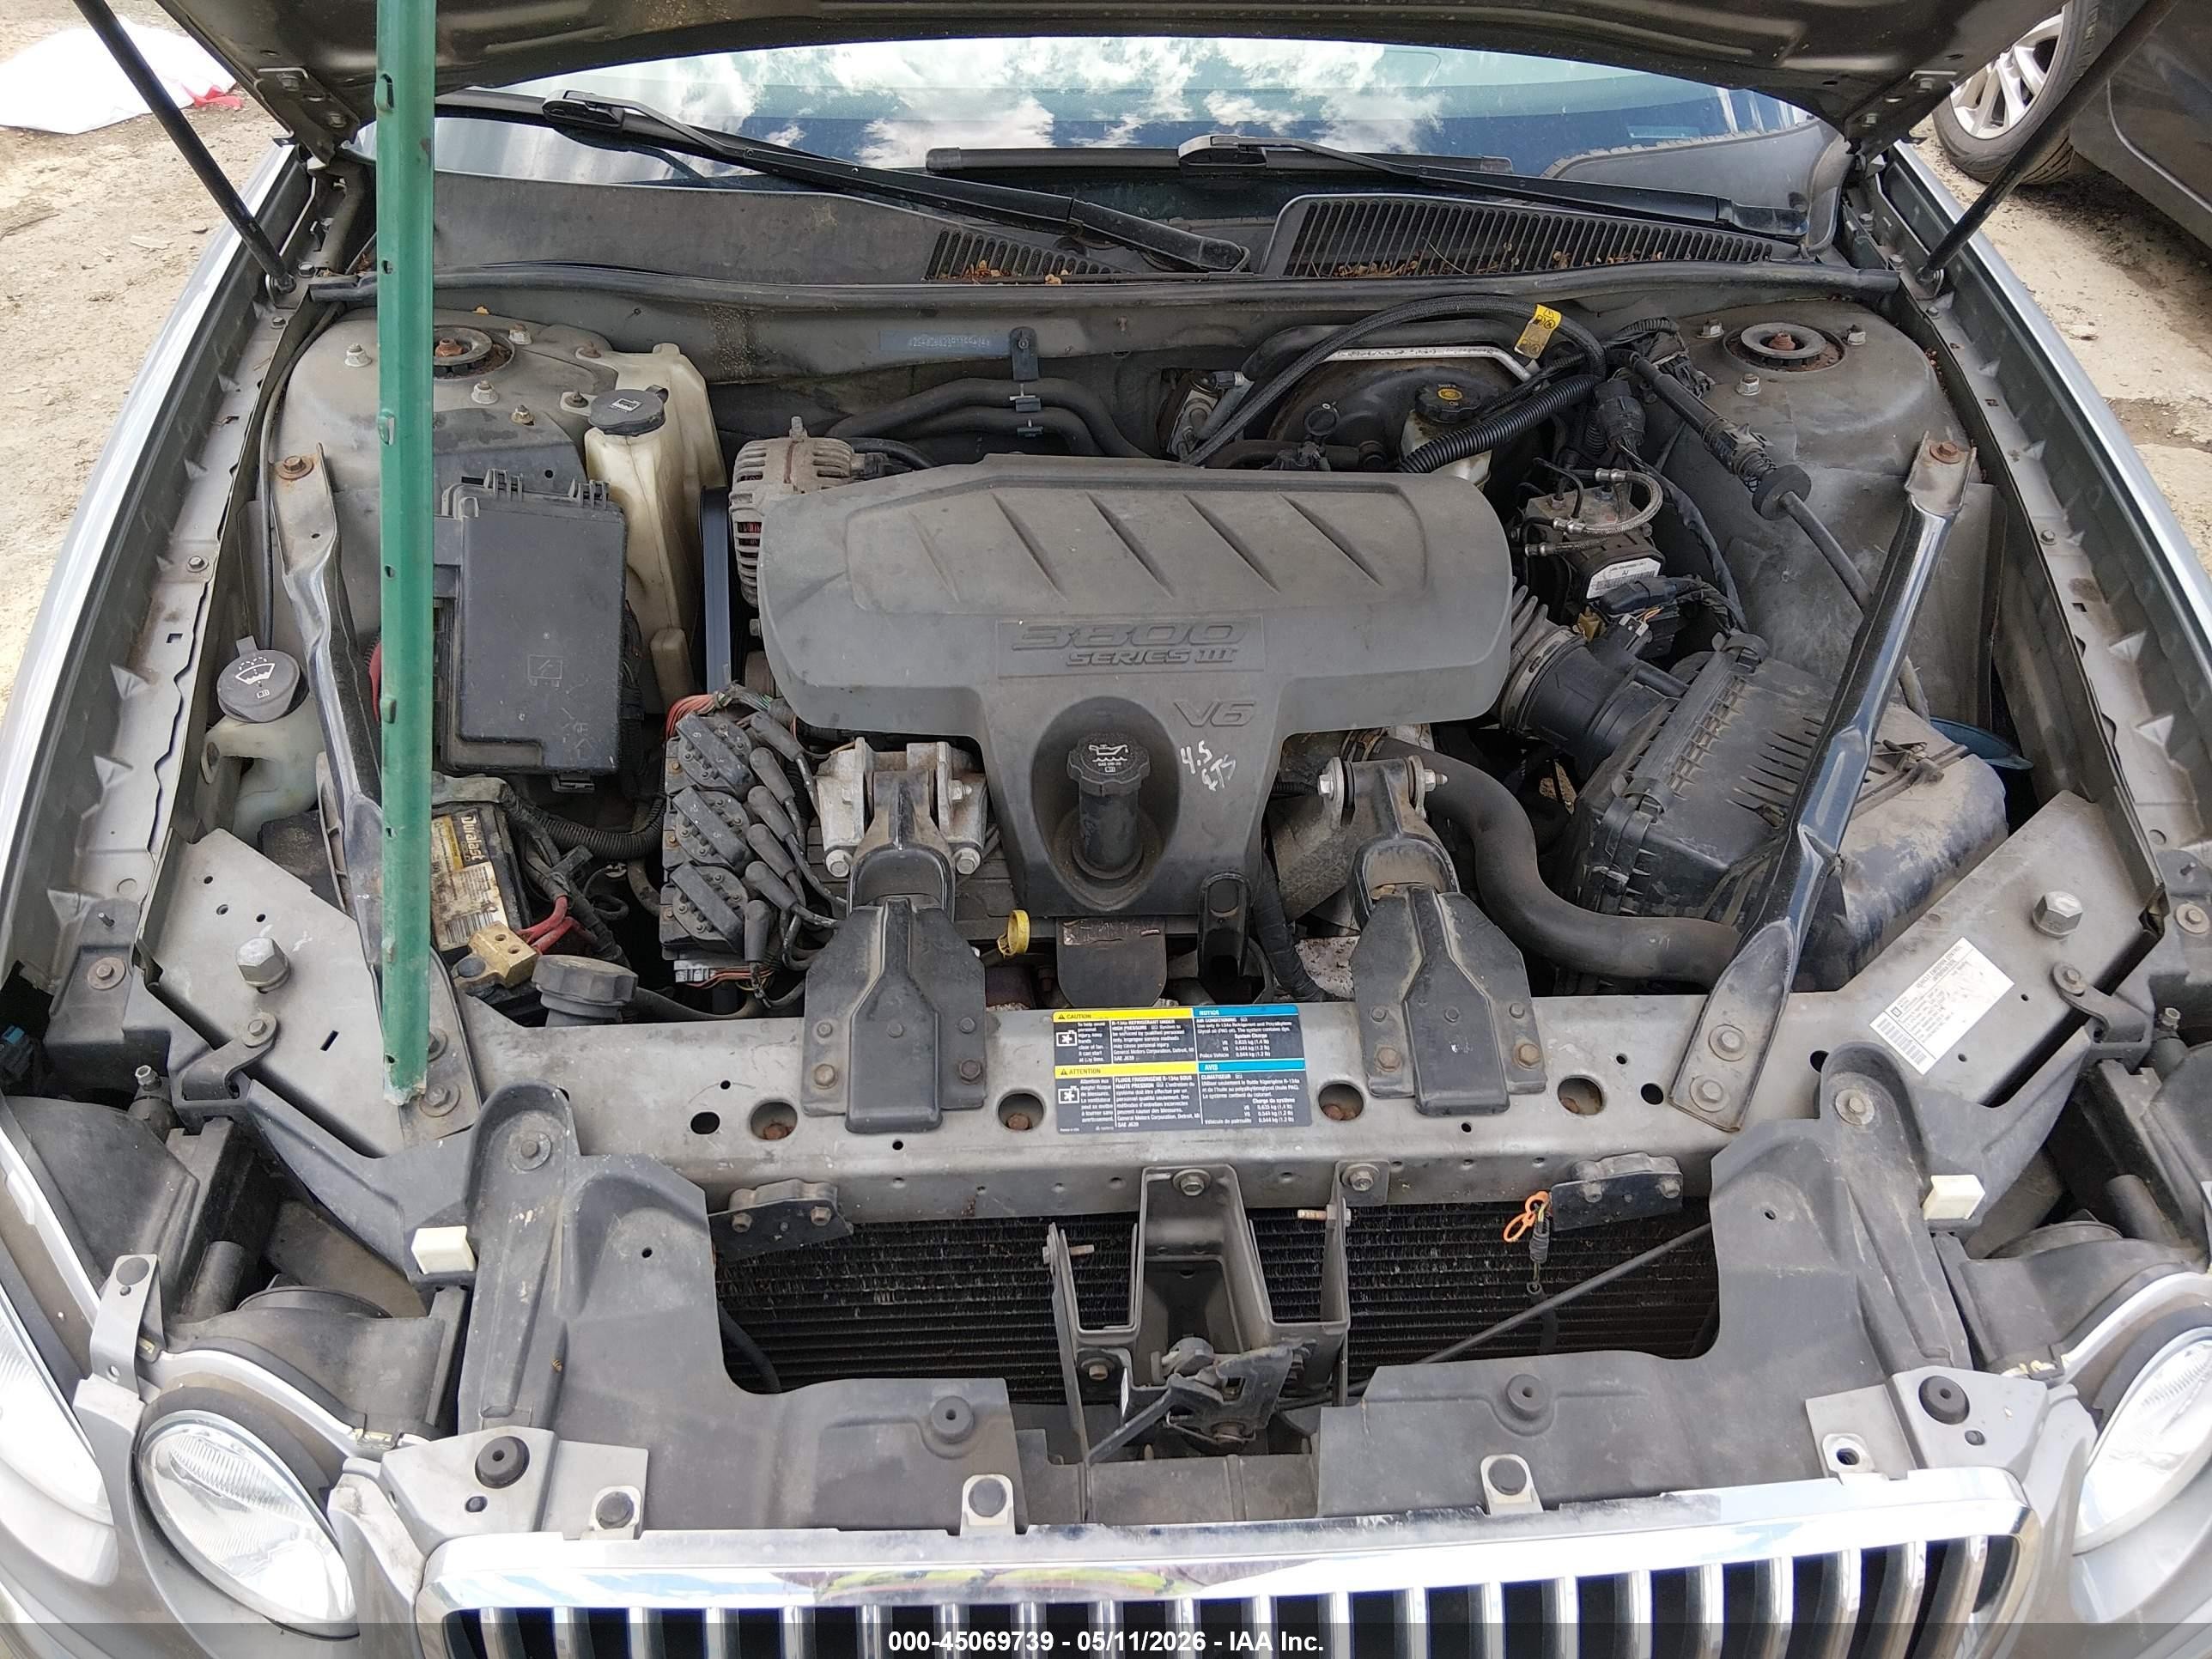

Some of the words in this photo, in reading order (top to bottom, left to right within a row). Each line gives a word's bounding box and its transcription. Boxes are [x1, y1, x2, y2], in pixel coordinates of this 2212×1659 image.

[1011, 622, 1249, 651] 3800
[1066, 648, 1191, 666] SERIES
[1174, 699, 1256, 727] V6
[1181, 739, 1212, 775] 4.5
[460, 814, 487, 861] Duralast
